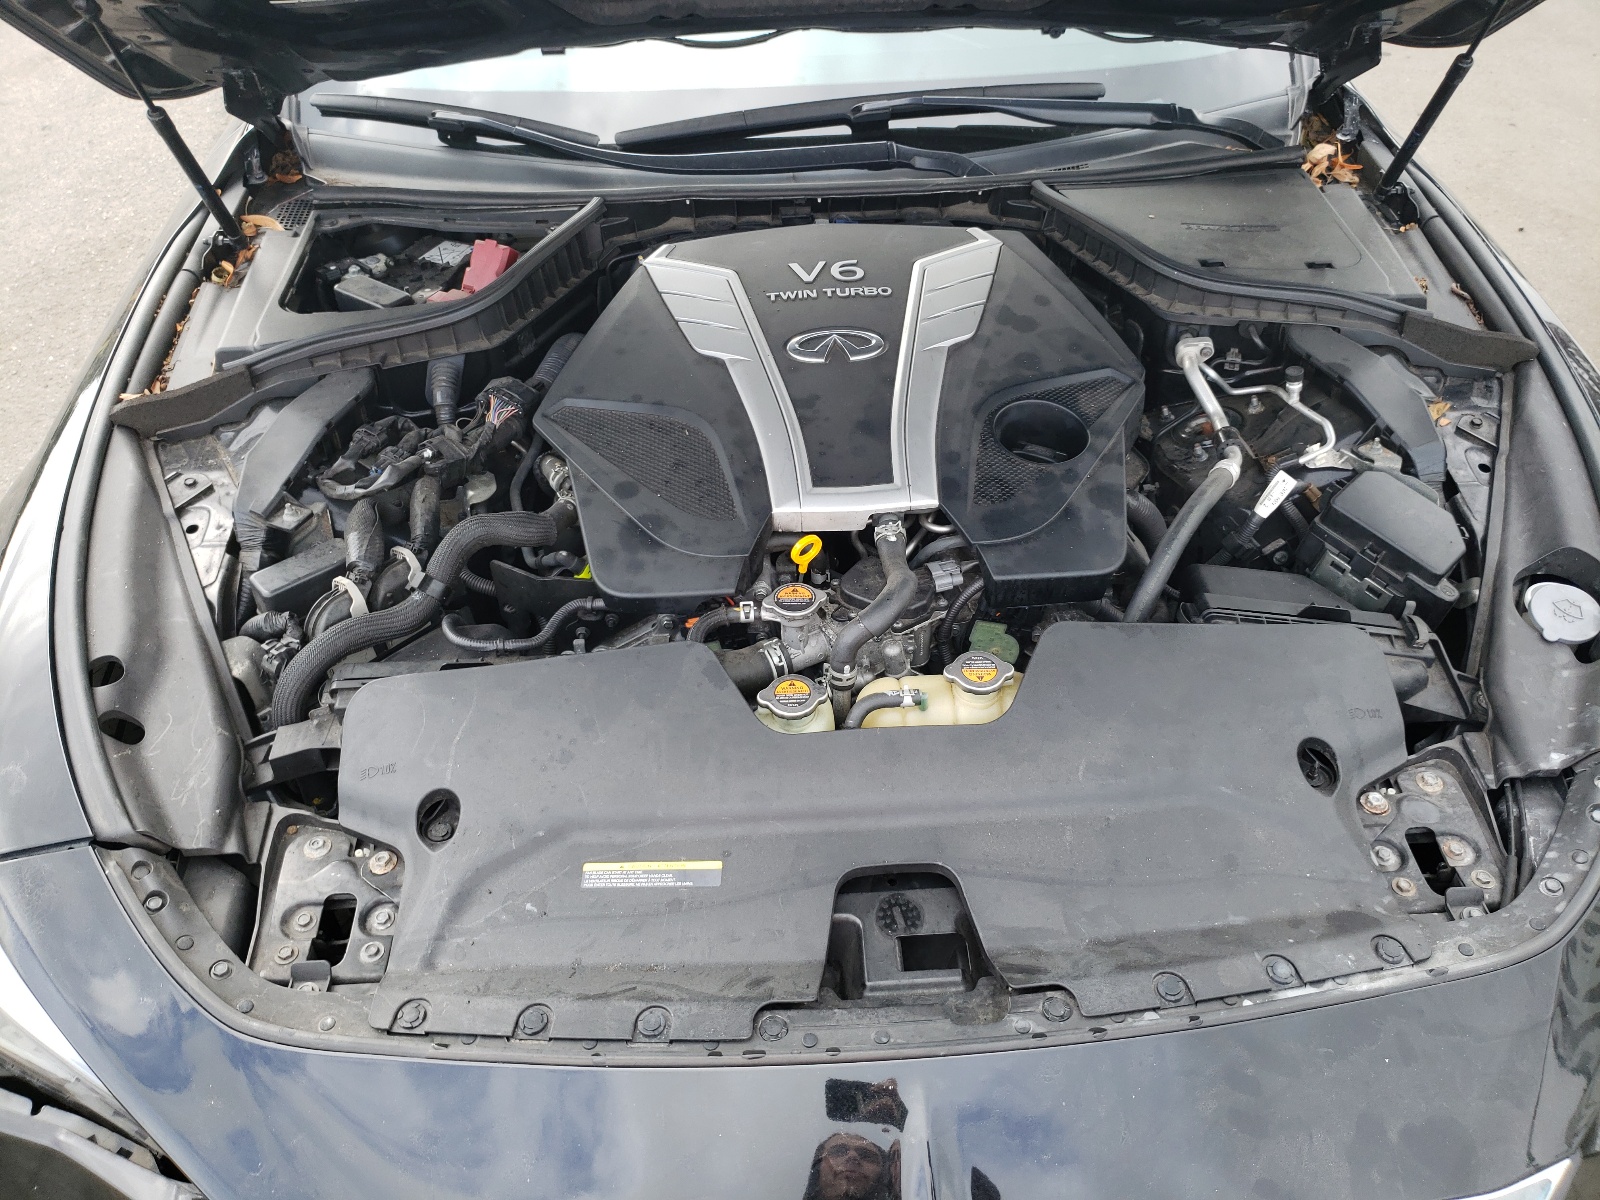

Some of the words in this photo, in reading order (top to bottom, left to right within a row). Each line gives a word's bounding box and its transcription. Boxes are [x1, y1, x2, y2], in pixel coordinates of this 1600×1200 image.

[788, 259, 865, 284] V6
[765, 289, 818, 302] TWIN
[822, 286, 893, 299] TURBO
